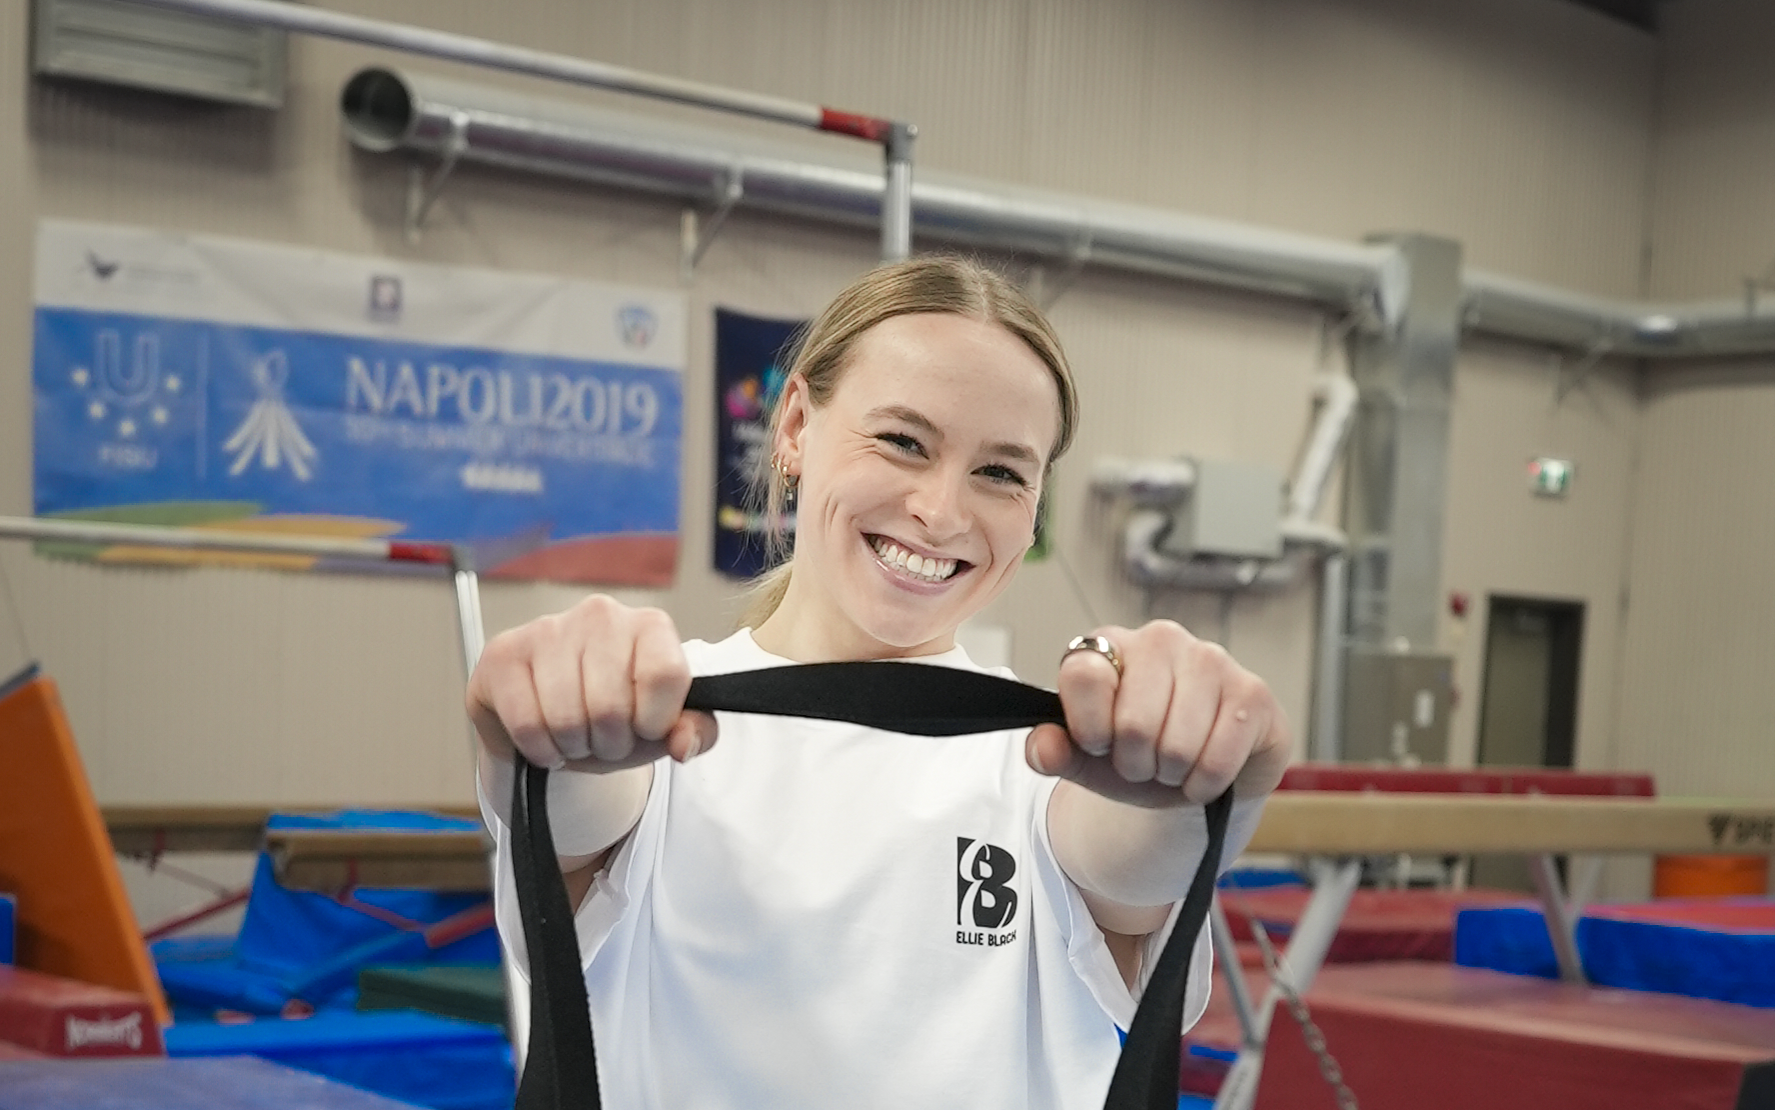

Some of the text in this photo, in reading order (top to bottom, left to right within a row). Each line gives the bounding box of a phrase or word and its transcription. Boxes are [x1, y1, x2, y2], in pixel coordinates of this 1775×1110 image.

[345, 356, 661, 437] NAPOLI2019
[956, 929, 1017, 947] ELLIE BLACK
